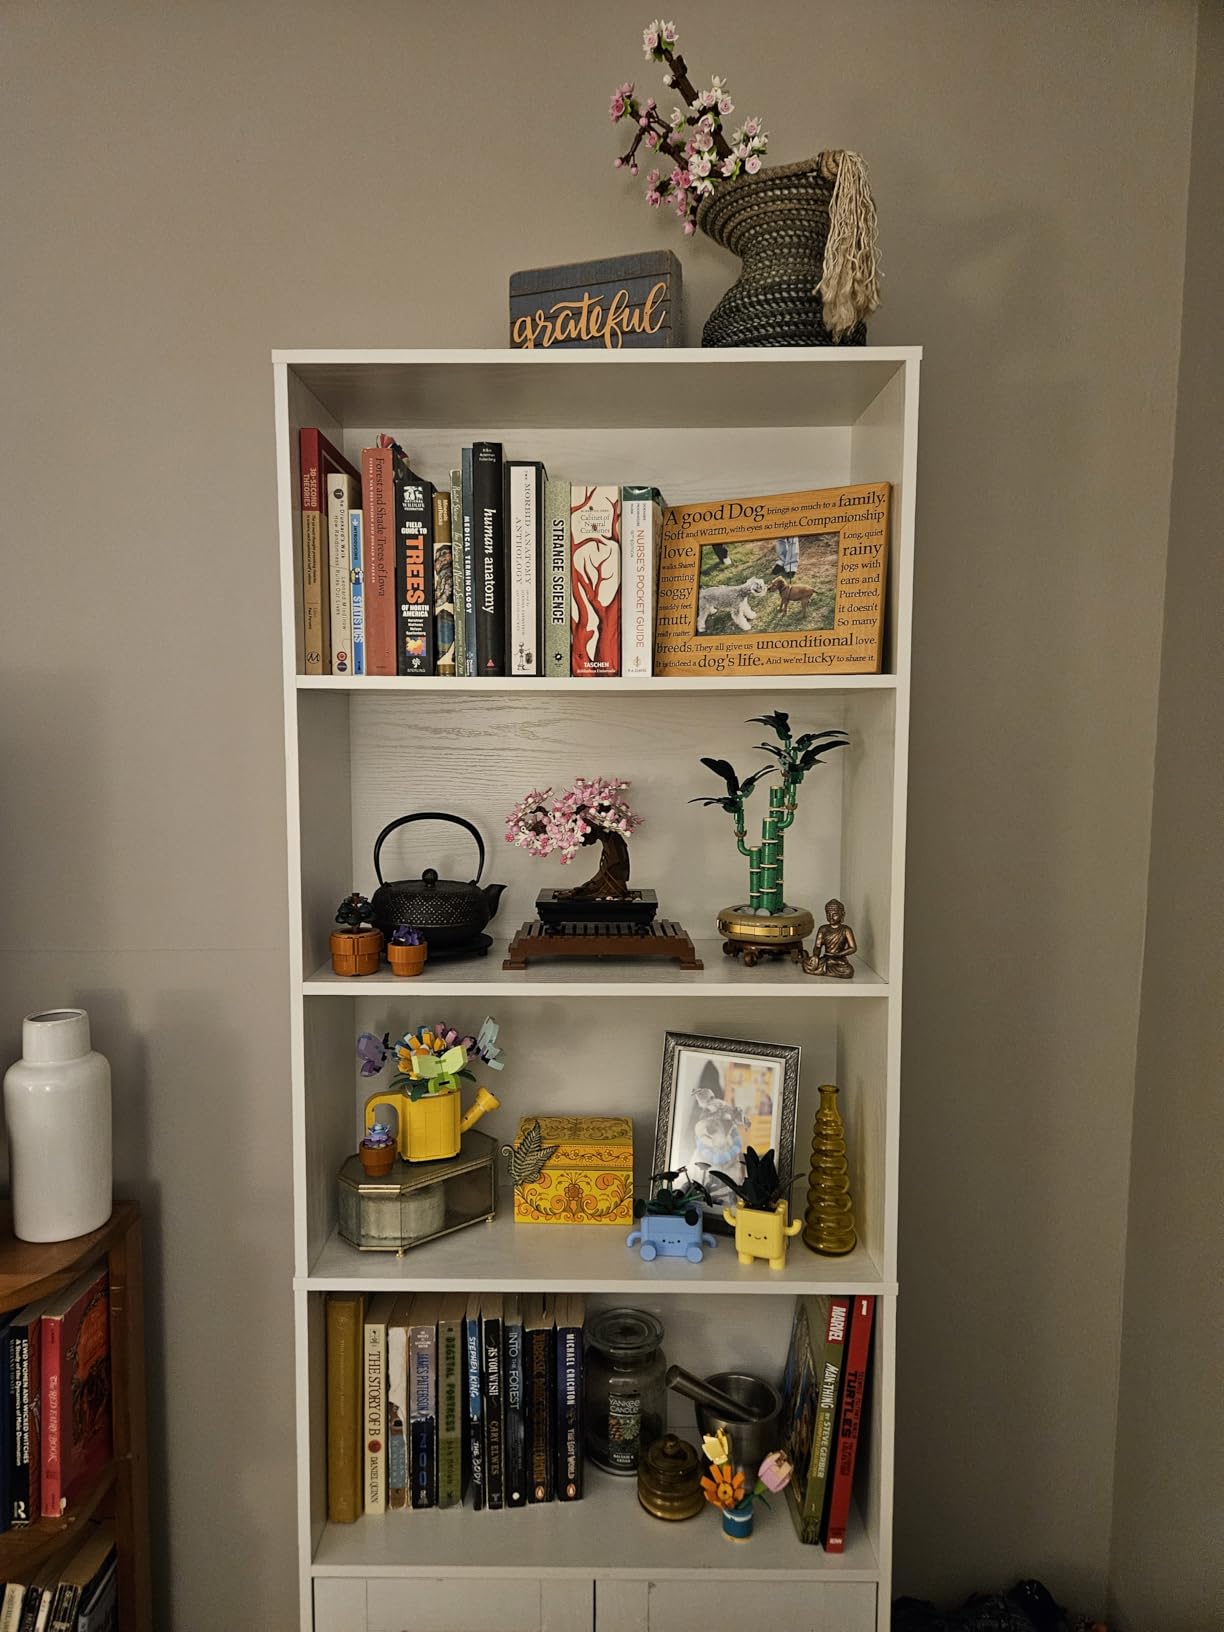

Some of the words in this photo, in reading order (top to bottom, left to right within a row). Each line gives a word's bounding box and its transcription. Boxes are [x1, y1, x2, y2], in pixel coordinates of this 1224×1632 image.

[513, 282, 667, 349] grateful
[376, 458, 385, 486] Forest
[376, 488, 386, 505] and
[376, 507, 386, 535] Shade
[666, 509, 678, 526] A
[681, 505, 724, 529] good
[728, 503, 766, 522] Dog
[801, 502, 821, 511] much
[838, 491, 886, 507] family.
[483, 508, 497, 554] human
[664, 530, 684, 540] Soft
[700, 527, 729, 536] warm,
[774, 520, 798, 530] bright.
[799, 509, 884, 528] Companionship
[864, 530, 883, 539] quiet
[377, 536, 386, 561] Trees
[552, 520, 564, 571] STRANGE
[636, 529, 645, 572] NURSE'S
[664, 545, 696, 559] love.
[843, 542, 883, 558] rainy
[378, 563, 388, 574] of
[406, 536, 425, 604] TREES
[662, 574, 694, 583] morning
[840, 562, 858, 573] jogs
[862, 574, 880, 583] and
[378, 575, 388, 597] Iowa
[482, 557, 495, 614] anatomy
[636, 575, 644, 614] POCKET
[660, 587, 693, 600] soggy
[840, 588, 880, 598] Purebred,
[552, 576, 564, 624] SCIENCE
[847, 603, 878, 613] doesn't
[352, 596, 363, 643] STATISTICS
[636, 616, 644, 647] GUIDE
[658, 614, 691, 626] mutt,
[838, 618, 849, 626] So
[852, 618, 877, 627] many
[656, 641, 694, 654] breeds.
[696, 644, 713, 653] They
[726, 643, 743, 652] give
[756, 633, 853, 650] unconditional
[855, 636, 877, 645] love.
[698, 654, 735, 671] dog's
[738, 653, 764, 666] life.
[804, 652, 835, 666] lucky
[862, 1299, 867, 1316] 1
[828, 1306, 846, 1341] MARVEL
[446, 1336, 456, 1378] DIGITAL
[469, 1336, 478, 1372] STEPHEN
[486, 1346, 498, 1356] AS
[508, 1332, 519, 1357] INTO
[566, 1333, 575, 1365] MICHAEL
[368, 1351, 381, 1375] THE
[416, 1352, 429, 1374] JAMES
[488, 1357, 498, 1372] YOU
[368, 1376, 381, 1410] STORY
[416, 1375, 429, 1411] PATTERSON
[469, 1375, 480, 1397] KING
[489, 1374, 498, 1395] WISH
[509, 1370, 520, 1409] FOREST
[566, 1369, 576, 1405] CRICHTON
[820, 1362, 839, 1408] MAN-THING
[48, 1390, 57, 1409] RED
[446, 1382, 456, 1431] FORTRESS
[842, 1371, 858, 1438] TURTLES
[368, 1412, 381, 1427] OF
[490, 1421, 499, 1442] CARY
[821, 1421, 831, 1446] STEVE
[48, 1436, 58, 1463] BOOK
[418, 1433, 427, 1486] ZOO
[491, 1446, 499, 1475] ELWES
[370, 1456, 379, 1480] DANIEL
[473, 1458, 482, 1483] BODY
[568, 1456, 576, 1478] WORLD
[818, 1447, 827, 1478] GERBER
[370, 1482, 379, 1504] QUINN
